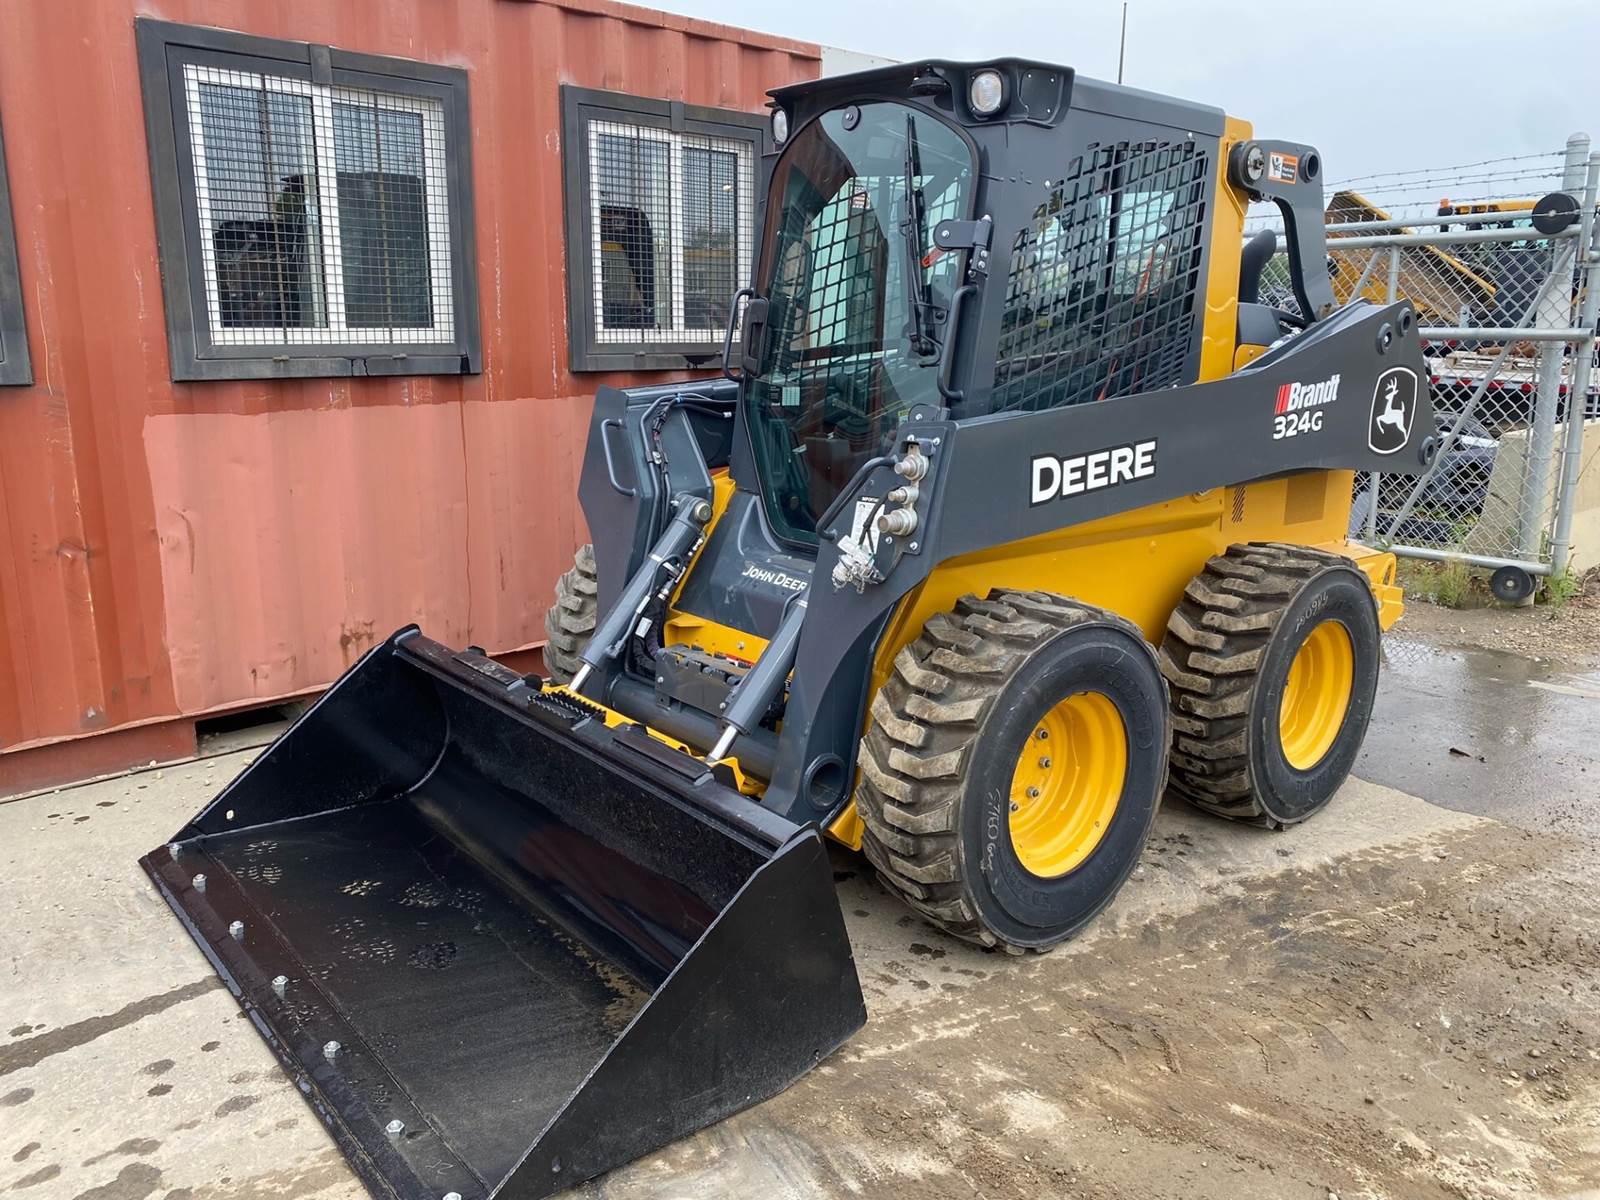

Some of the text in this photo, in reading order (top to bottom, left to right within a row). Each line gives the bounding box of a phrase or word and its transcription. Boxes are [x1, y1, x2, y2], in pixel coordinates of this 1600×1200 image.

[1287, 374, 1340, 412] Brandt
[1273, 410, 1323, 440] 324G
[1031, 441, 1156, 504] DEERE
[742, 565, 808, 591] JOHN DEER
